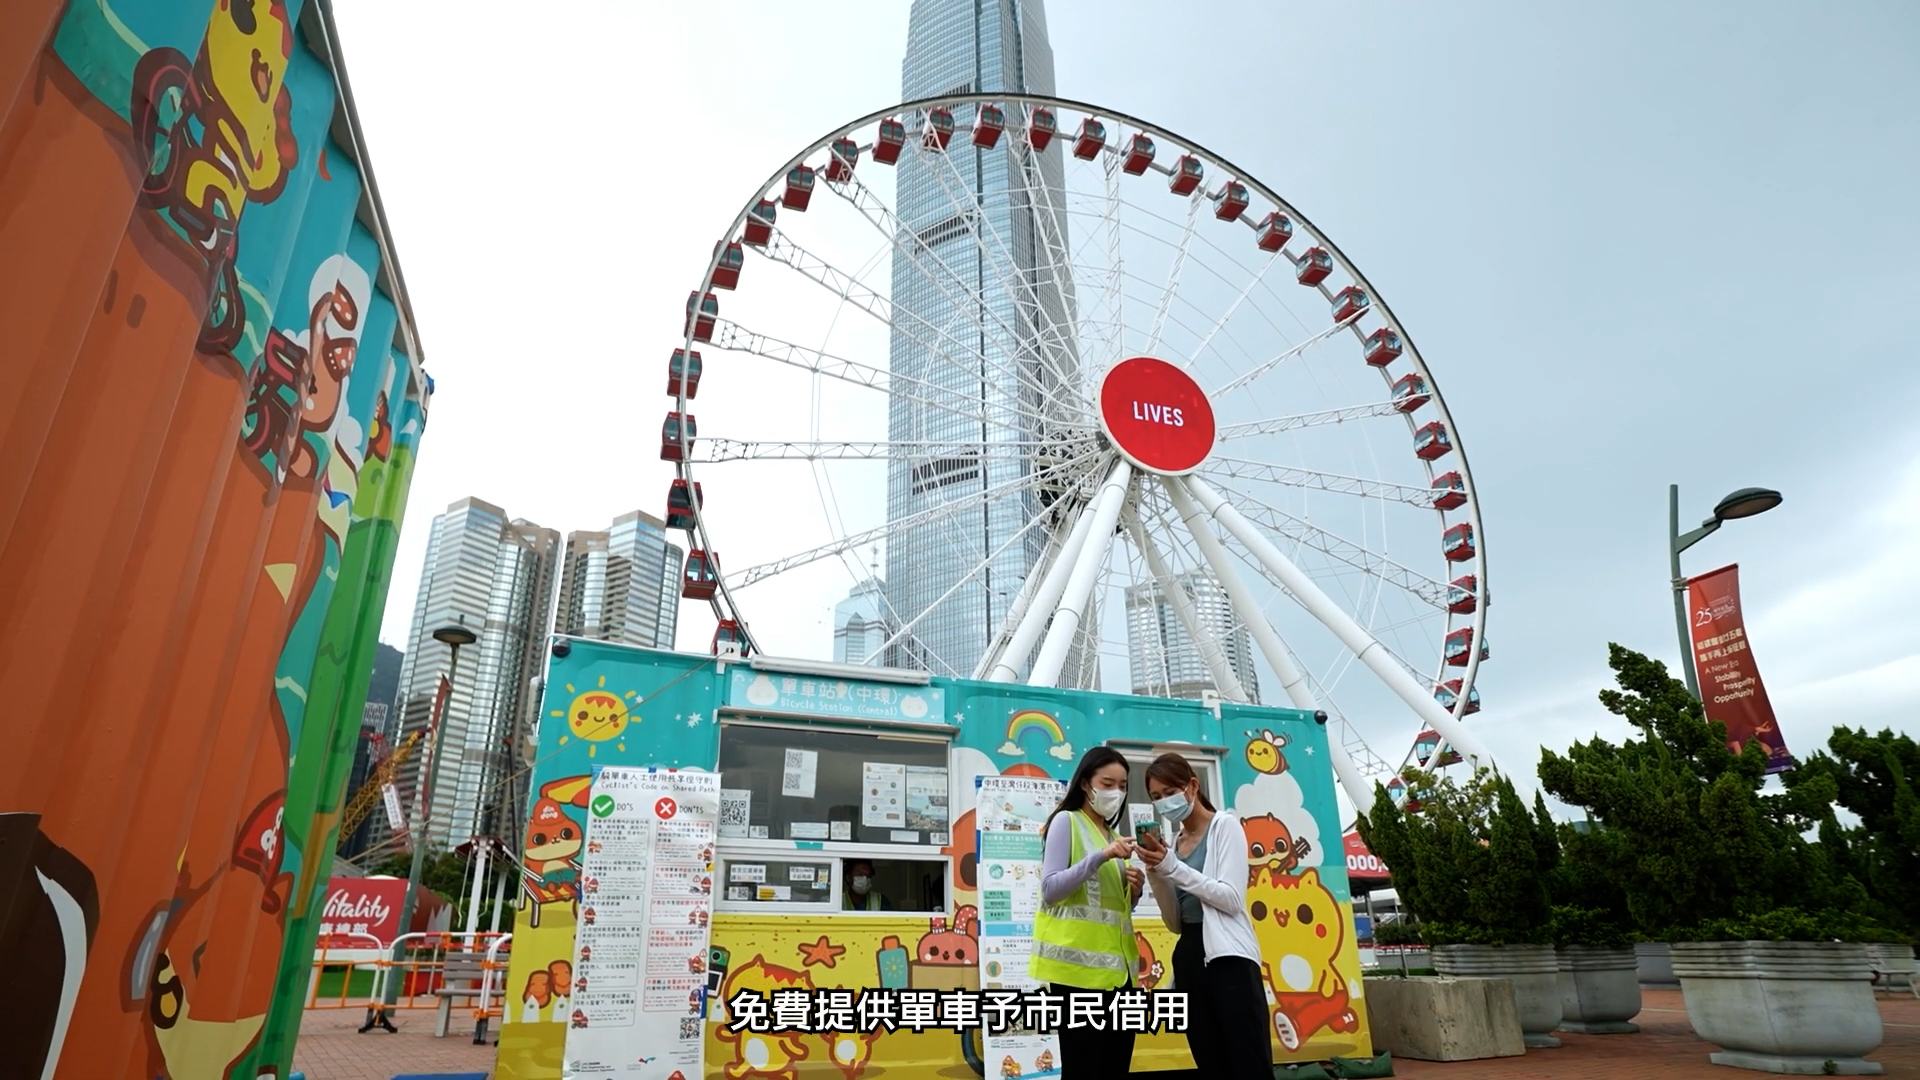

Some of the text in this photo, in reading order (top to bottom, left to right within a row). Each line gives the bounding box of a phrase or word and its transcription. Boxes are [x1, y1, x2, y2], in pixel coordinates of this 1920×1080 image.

[1133, 401, 1184, 427] LIVES
[1696, 607, 1713, 627] 25
[1711, 663, 1729, 674] New
[781, 678, 835, 698] 單車站
[1713, 688, 1755, 704] Opportunity
[781, 697, 898, 717] Bicycle Station (Central)
[641, 782, 658, 791] Code
[672, 784, 697, 792] Shared
